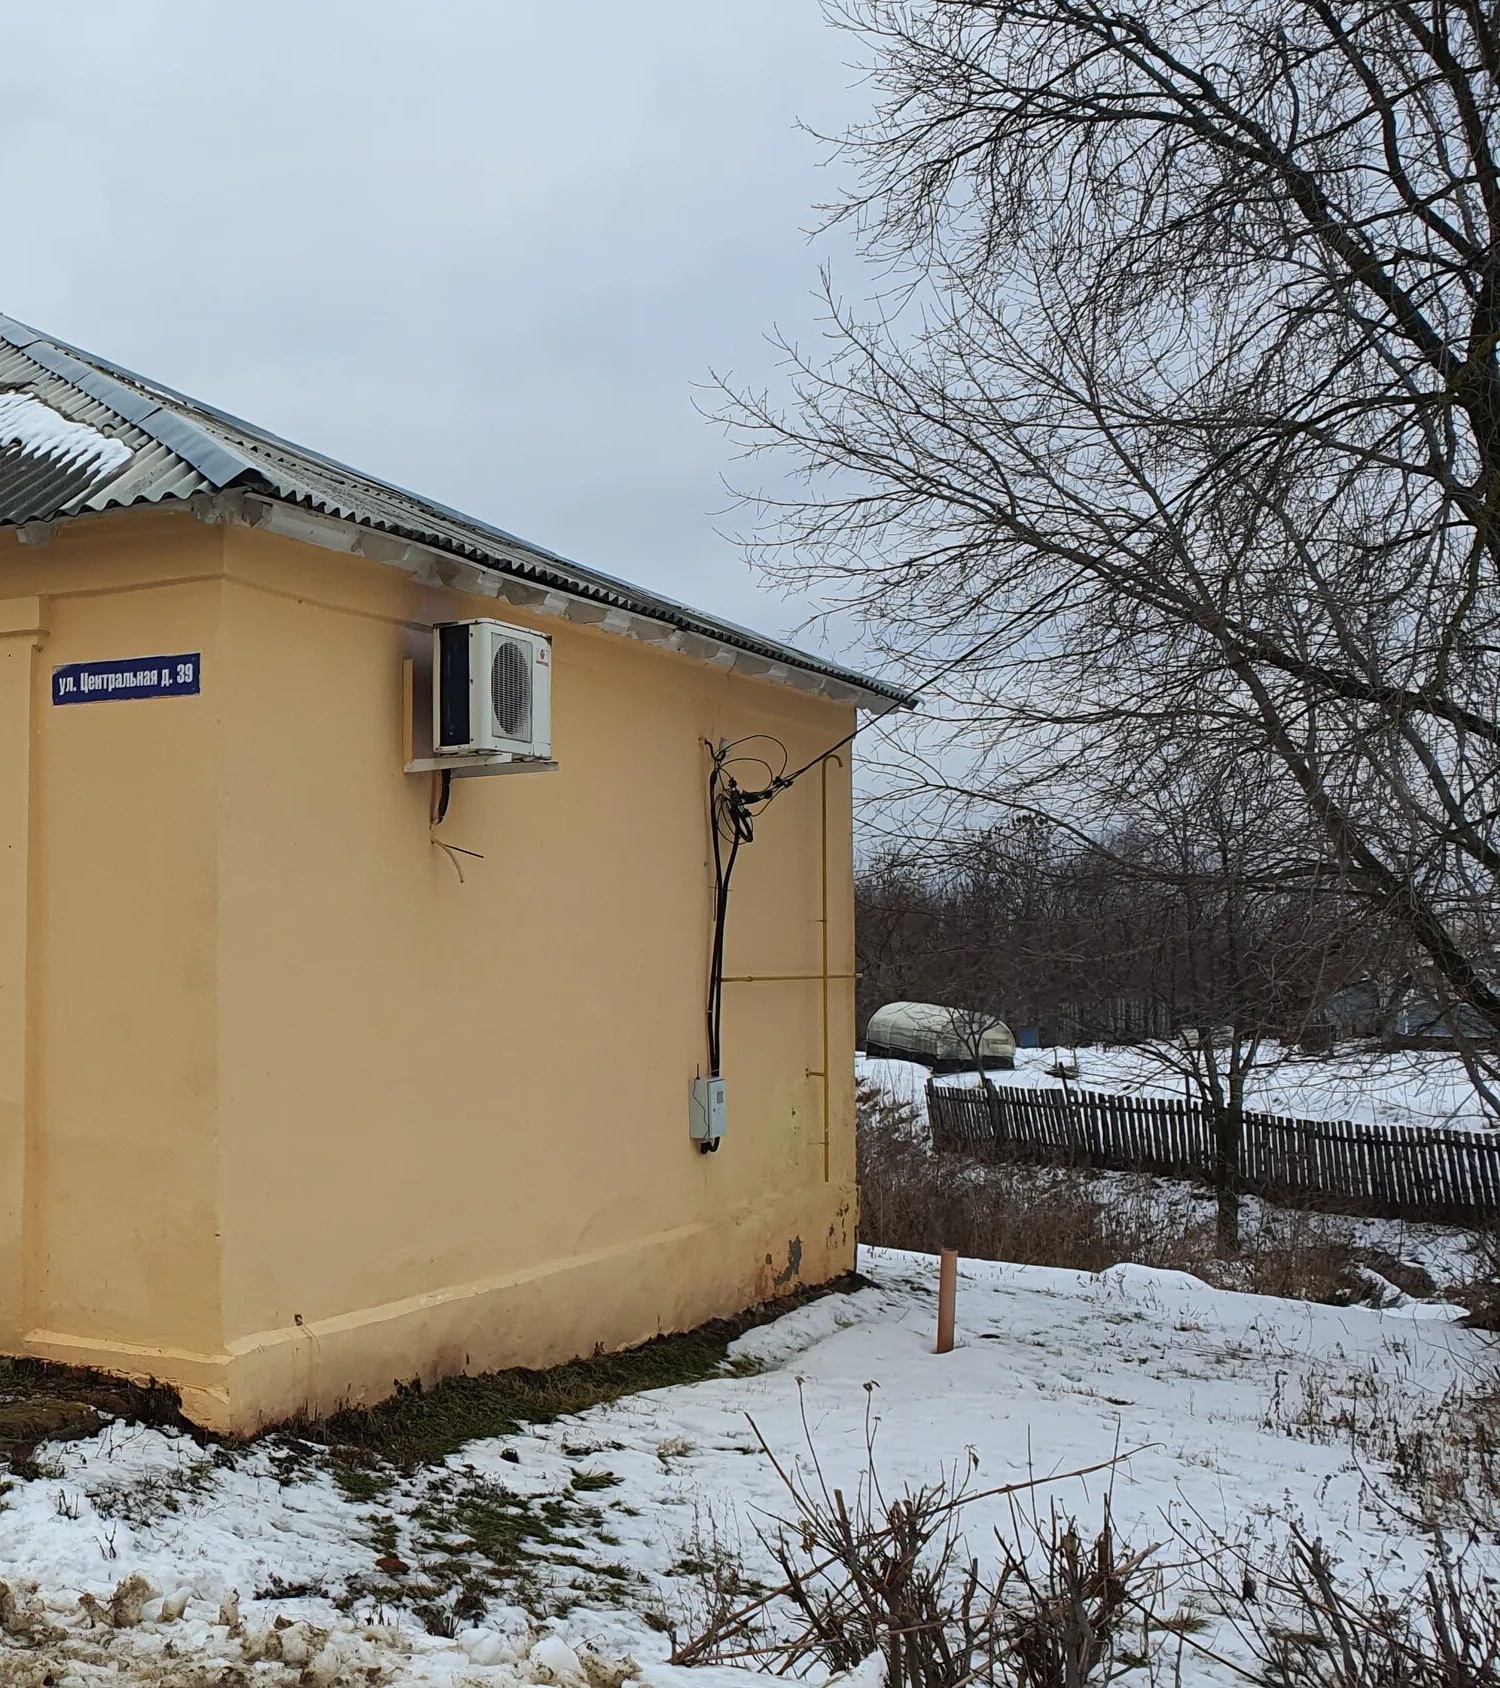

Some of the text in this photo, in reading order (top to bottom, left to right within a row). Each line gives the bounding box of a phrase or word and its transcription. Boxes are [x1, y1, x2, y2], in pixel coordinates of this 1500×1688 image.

[59, 663, 193, 695] ул. Центральная д. 39
